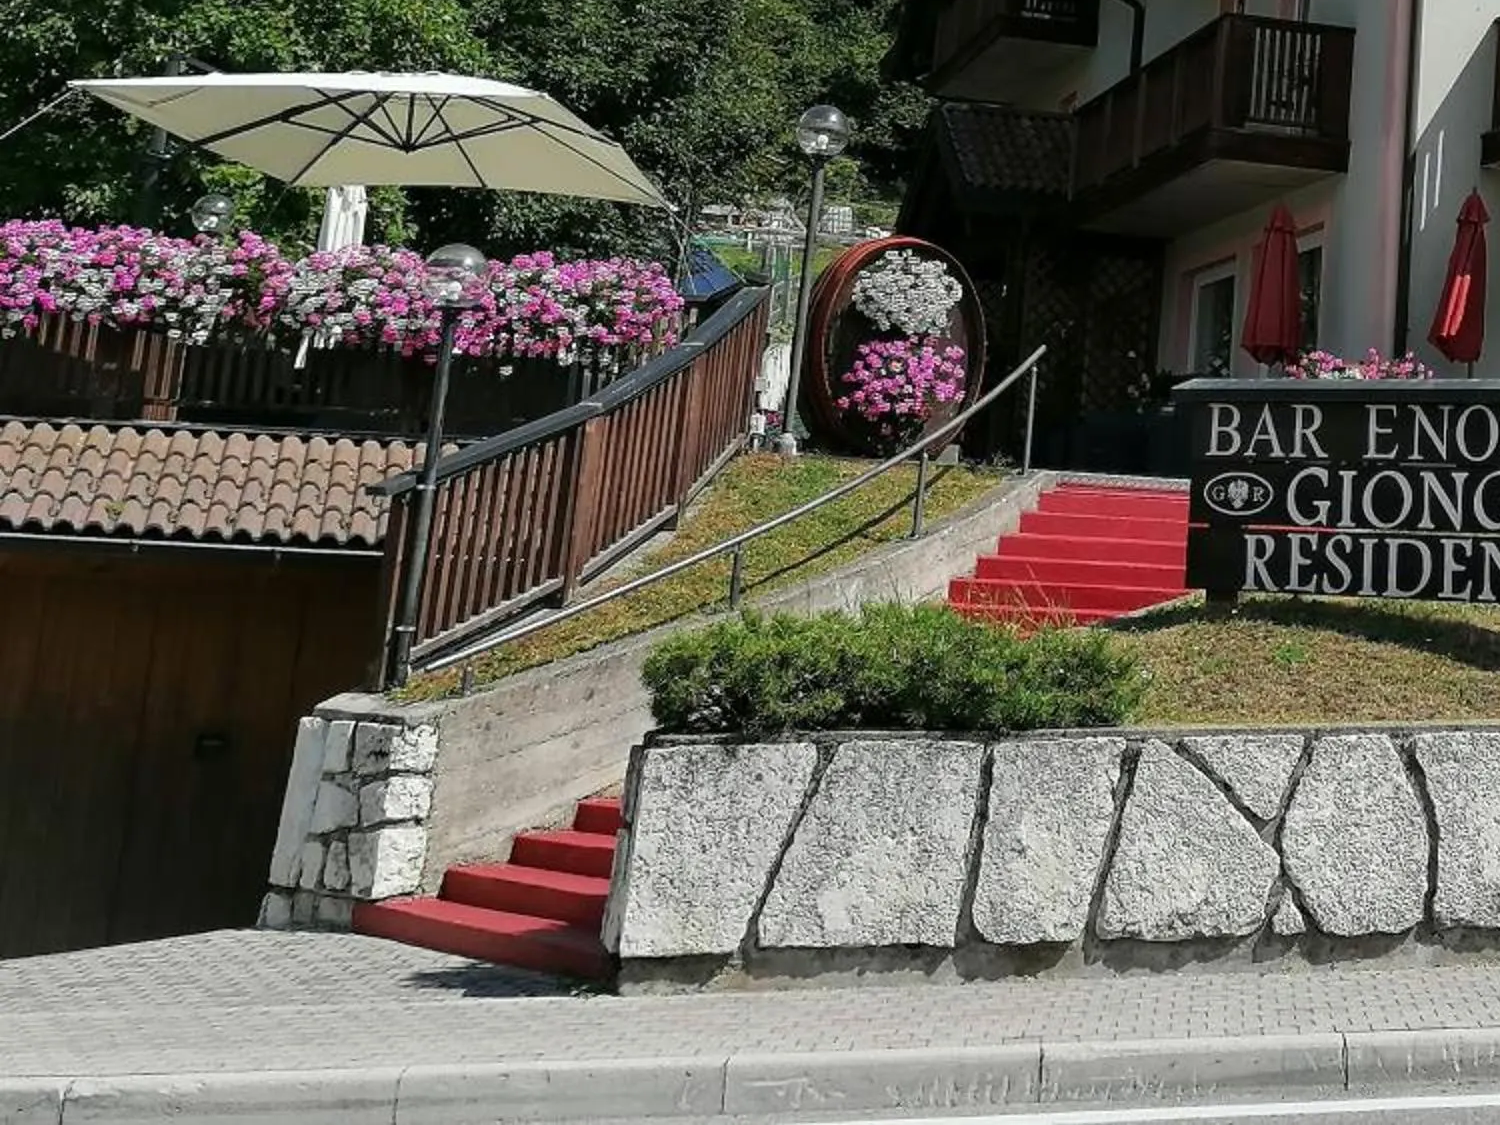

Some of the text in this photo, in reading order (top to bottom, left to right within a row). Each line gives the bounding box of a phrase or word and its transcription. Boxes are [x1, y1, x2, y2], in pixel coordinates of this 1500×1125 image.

[1204, 402, 1330, 460] BAR
[1212, 484, 1265, 502] G R
